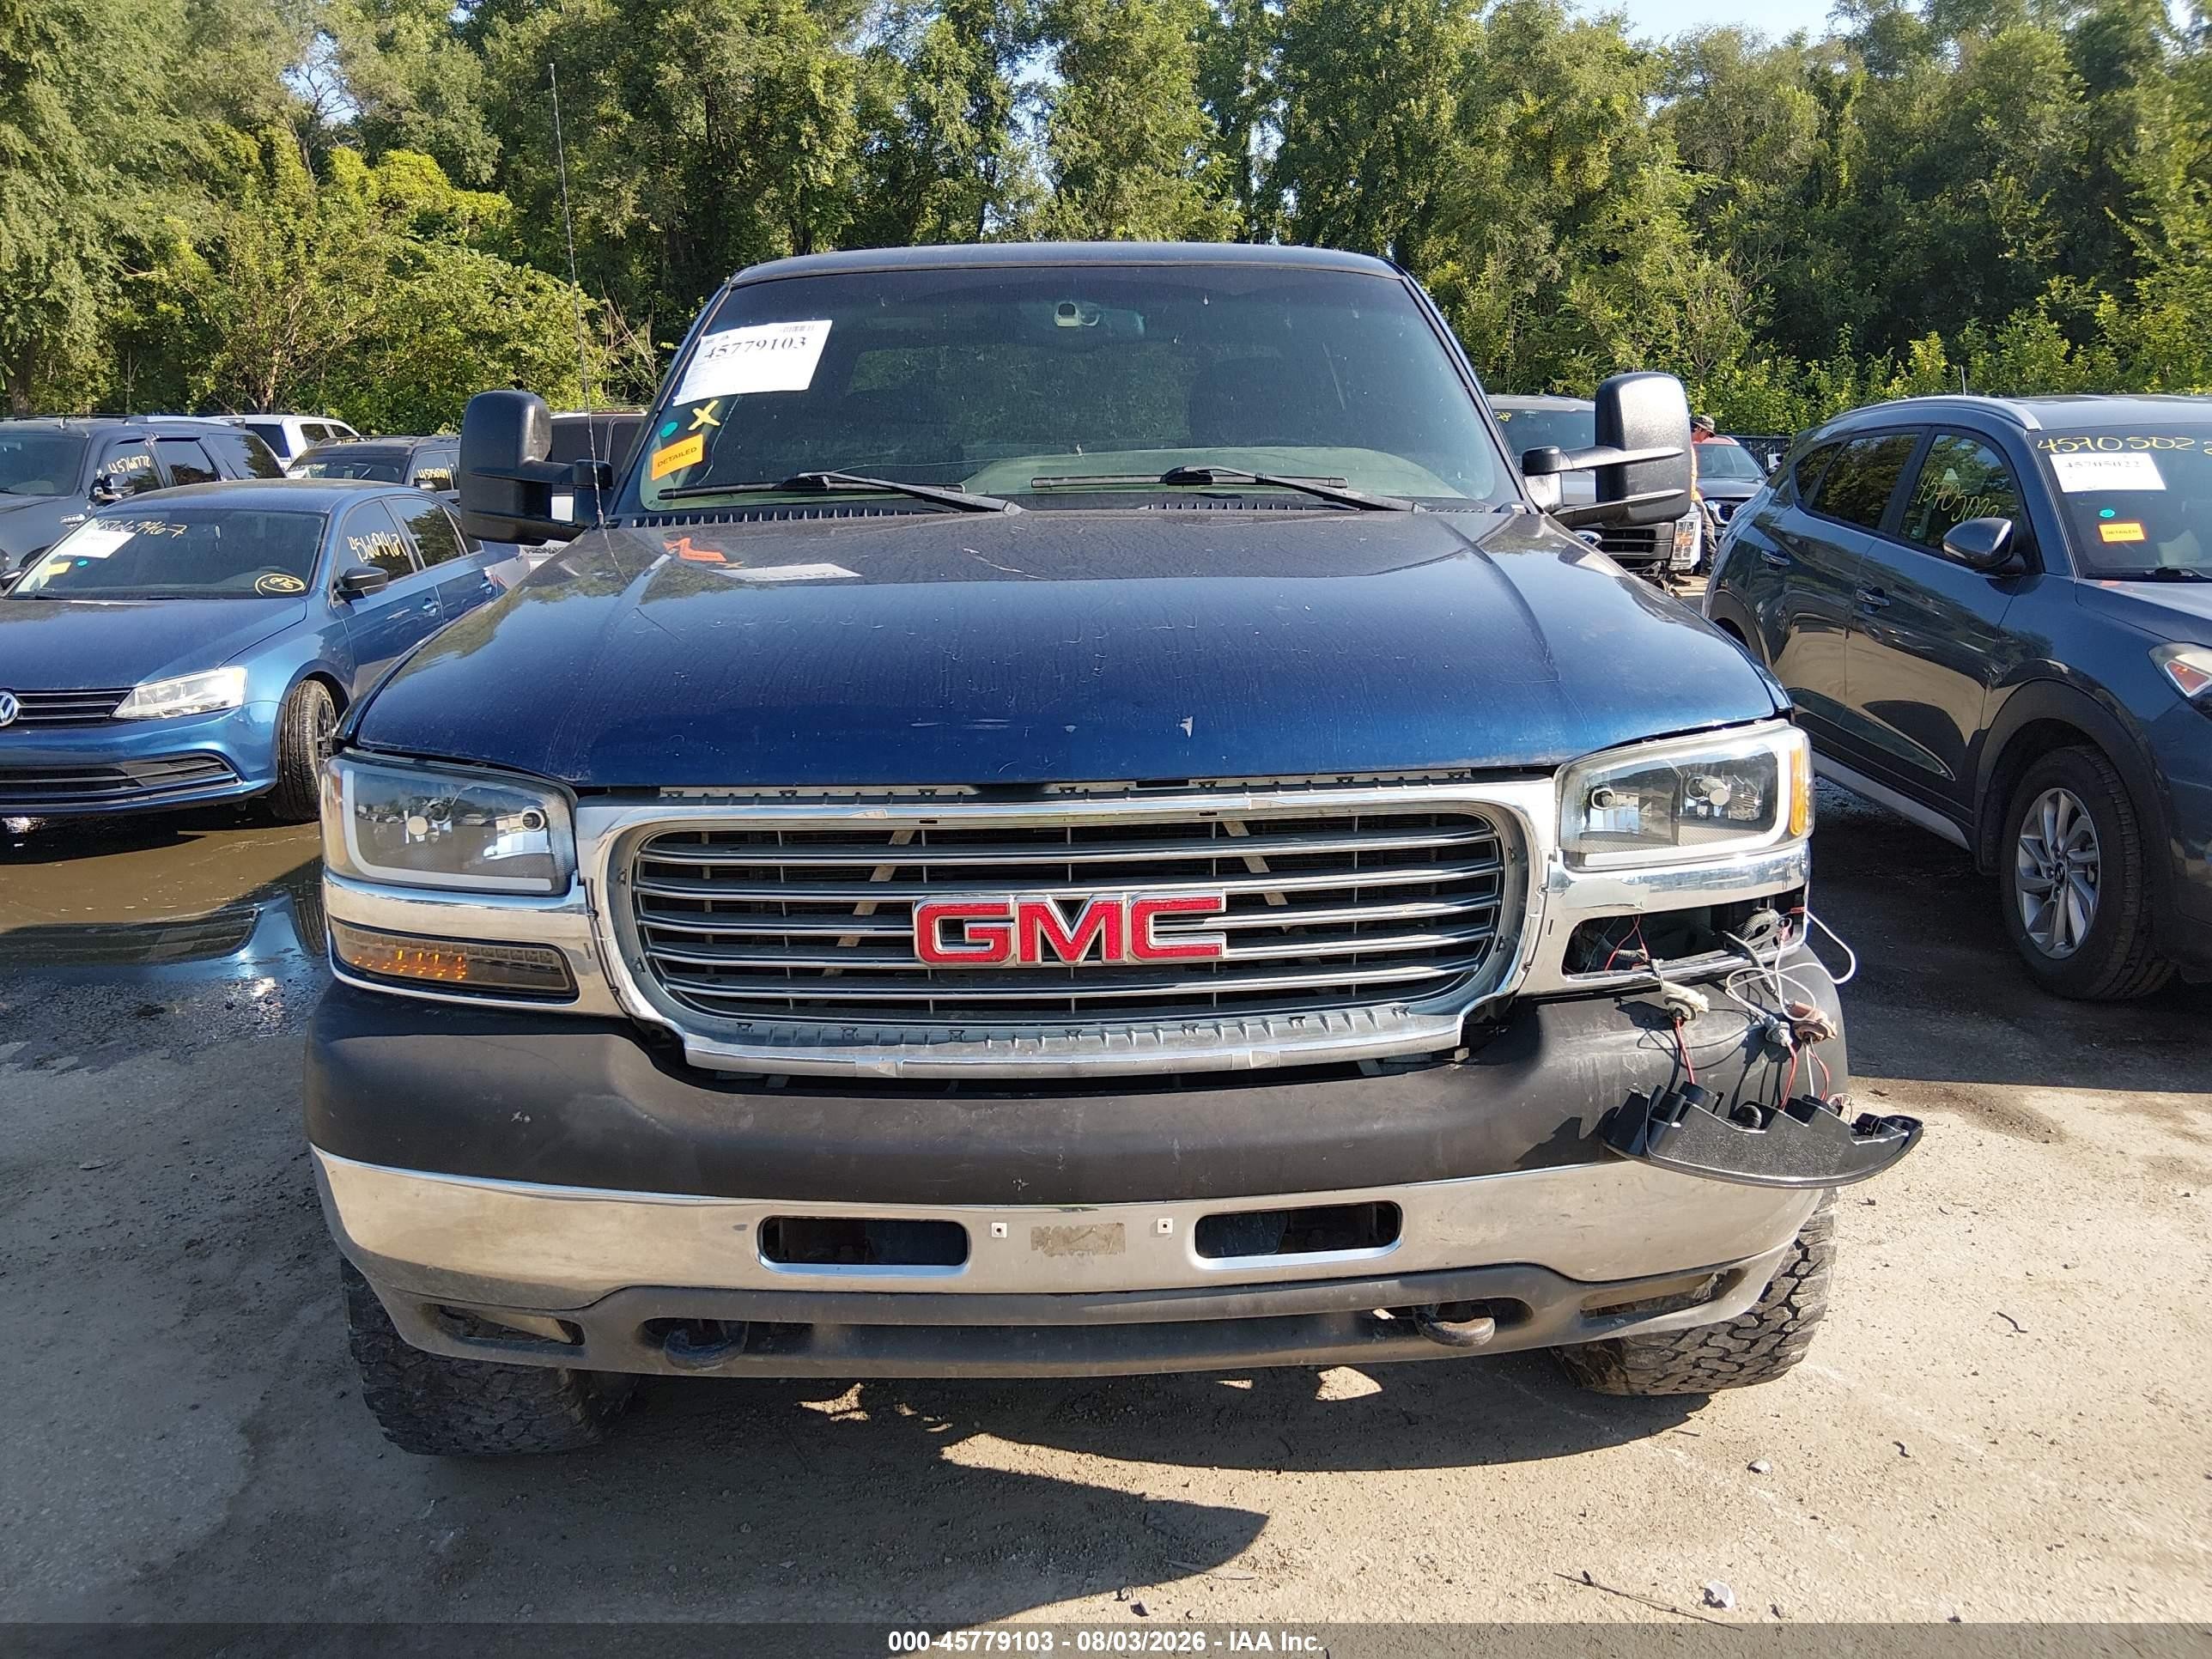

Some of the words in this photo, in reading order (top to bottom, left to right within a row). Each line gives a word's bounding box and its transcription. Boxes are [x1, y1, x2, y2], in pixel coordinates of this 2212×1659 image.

[704, 336, 808, 359] 45779103
[657, 447, 698, 468] DETAILED
[913, 890, 1227, 968] GMC
